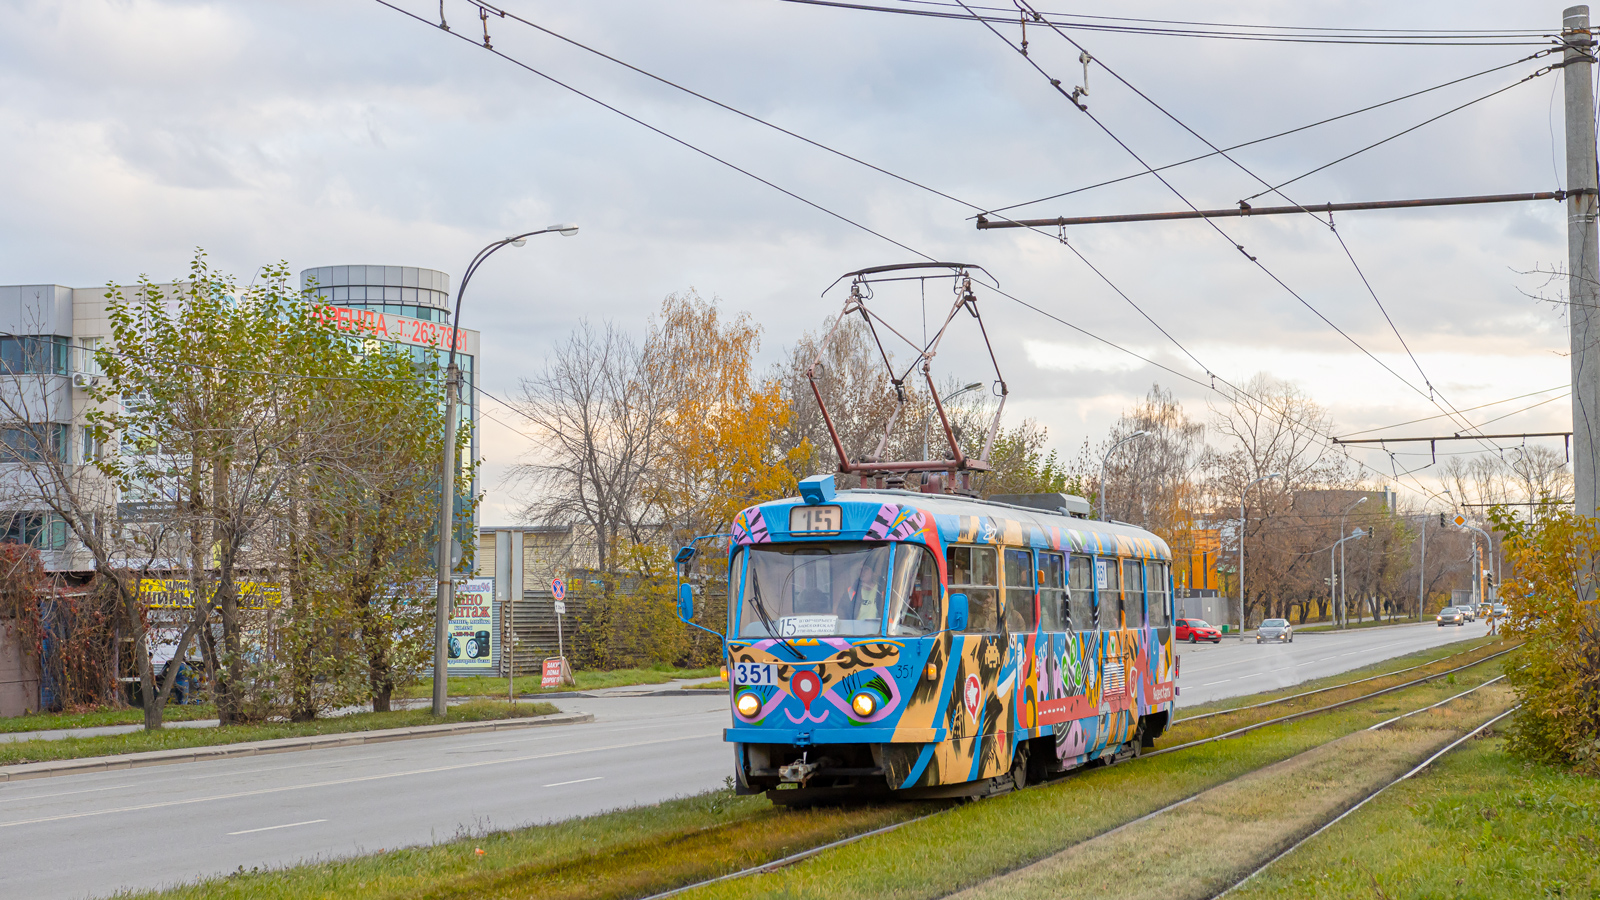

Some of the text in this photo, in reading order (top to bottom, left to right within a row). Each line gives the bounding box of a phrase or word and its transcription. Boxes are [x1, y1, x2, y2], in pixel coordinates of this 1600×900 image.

[311, 304, 388, 336] АРЕНДА
[803, 509, 832, 535] 15
[780, 617, 797, 637] 15
[737, 664, 772, 684] 351
[896, 664, 914, 679] 351
